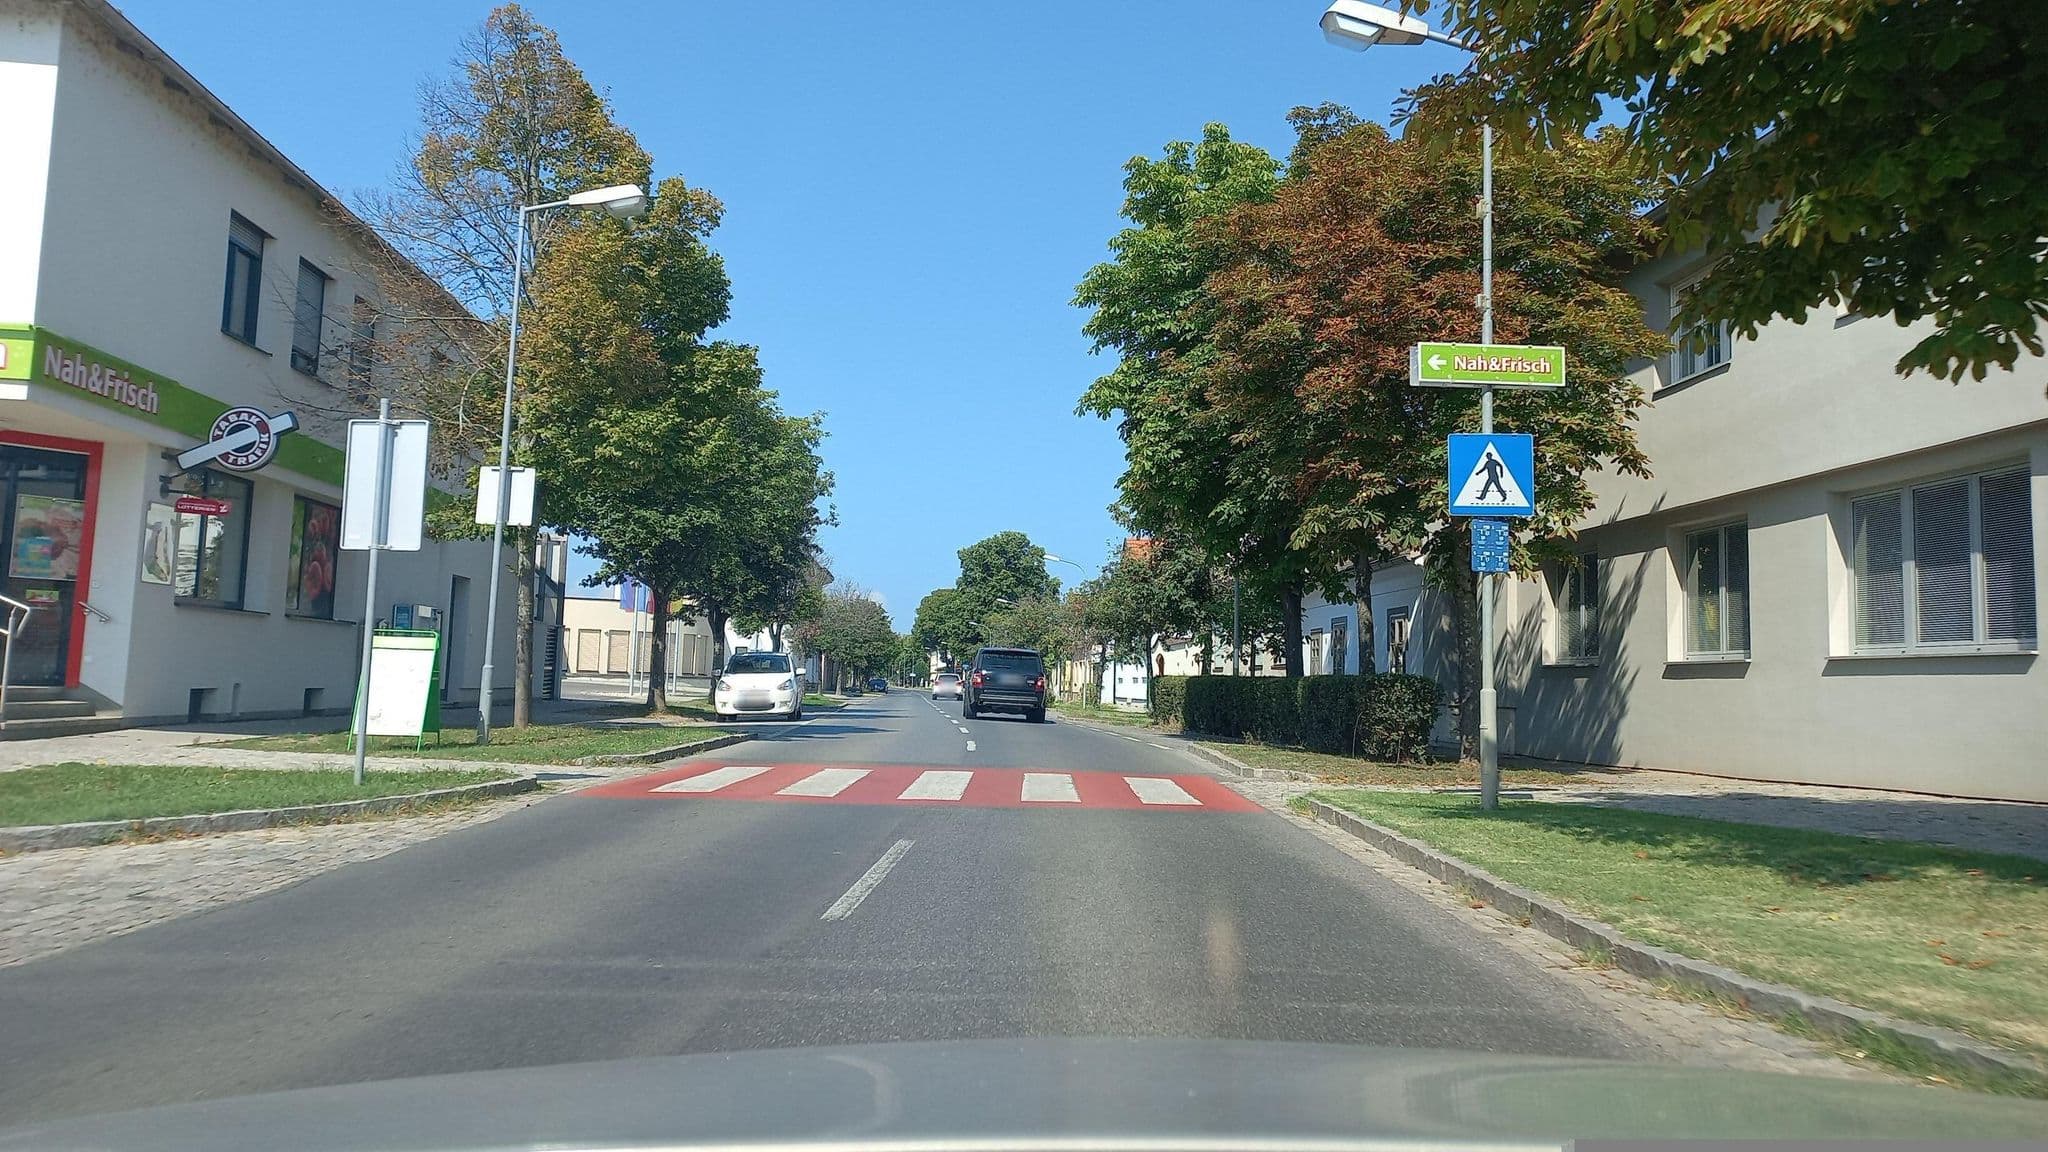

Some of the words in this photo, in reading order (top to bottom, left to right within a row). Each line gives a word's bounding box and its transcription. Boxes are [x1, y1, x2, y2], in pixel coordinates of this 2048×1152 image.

[44, 344, 159, 414] Nah&Frisch
[1453, 355, 1552, 374] Nah&Frisch
[213, 412, 260, 438] TABAK
[226, 432, 270, 465] TRAFIK
